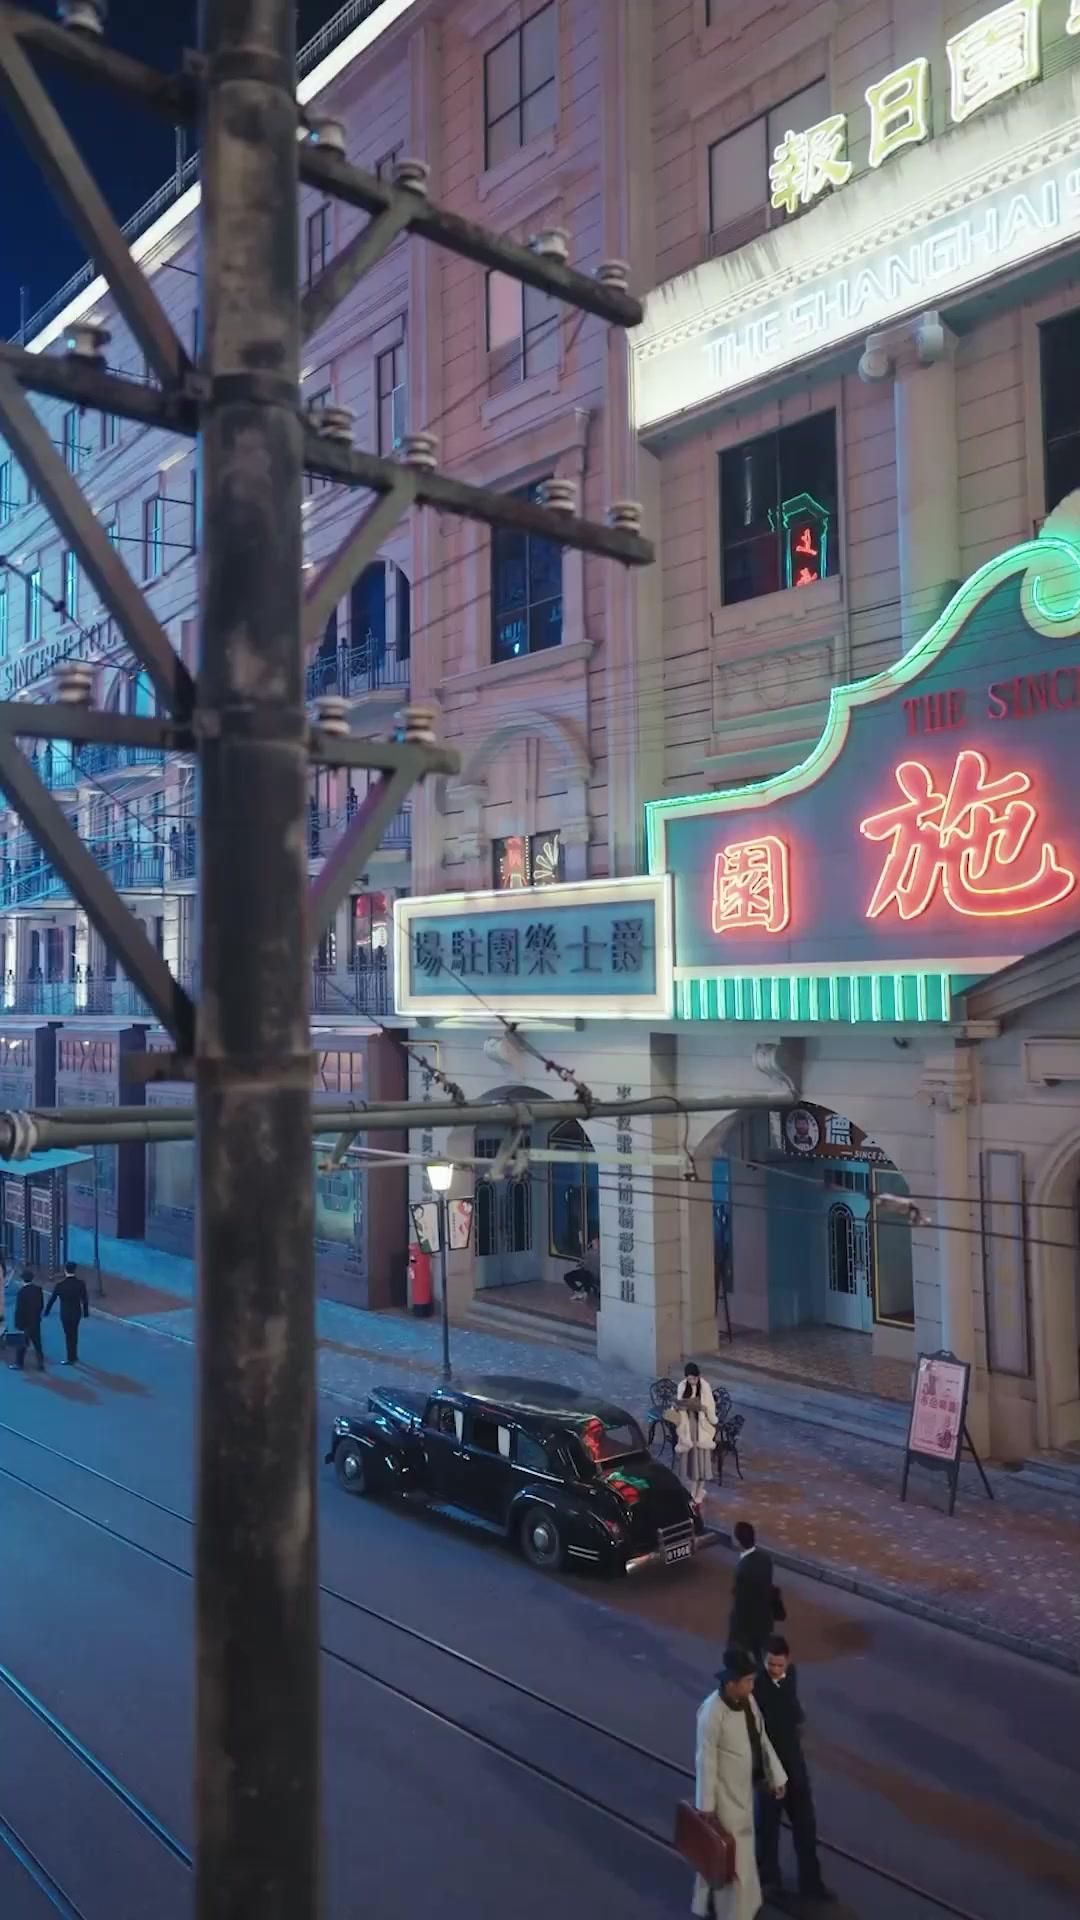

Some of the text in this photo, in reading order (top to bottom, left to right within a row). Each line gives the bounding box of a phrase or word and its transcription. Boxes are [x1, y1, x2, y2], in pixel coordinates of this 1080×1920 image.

[702, 179, 1060, 381] THE SHANGHAI
[902, 667, 1080, 737] THE SINC
[859, 750, 1076, 918] 施
[854, 1150, 876, 1160] SINCE
